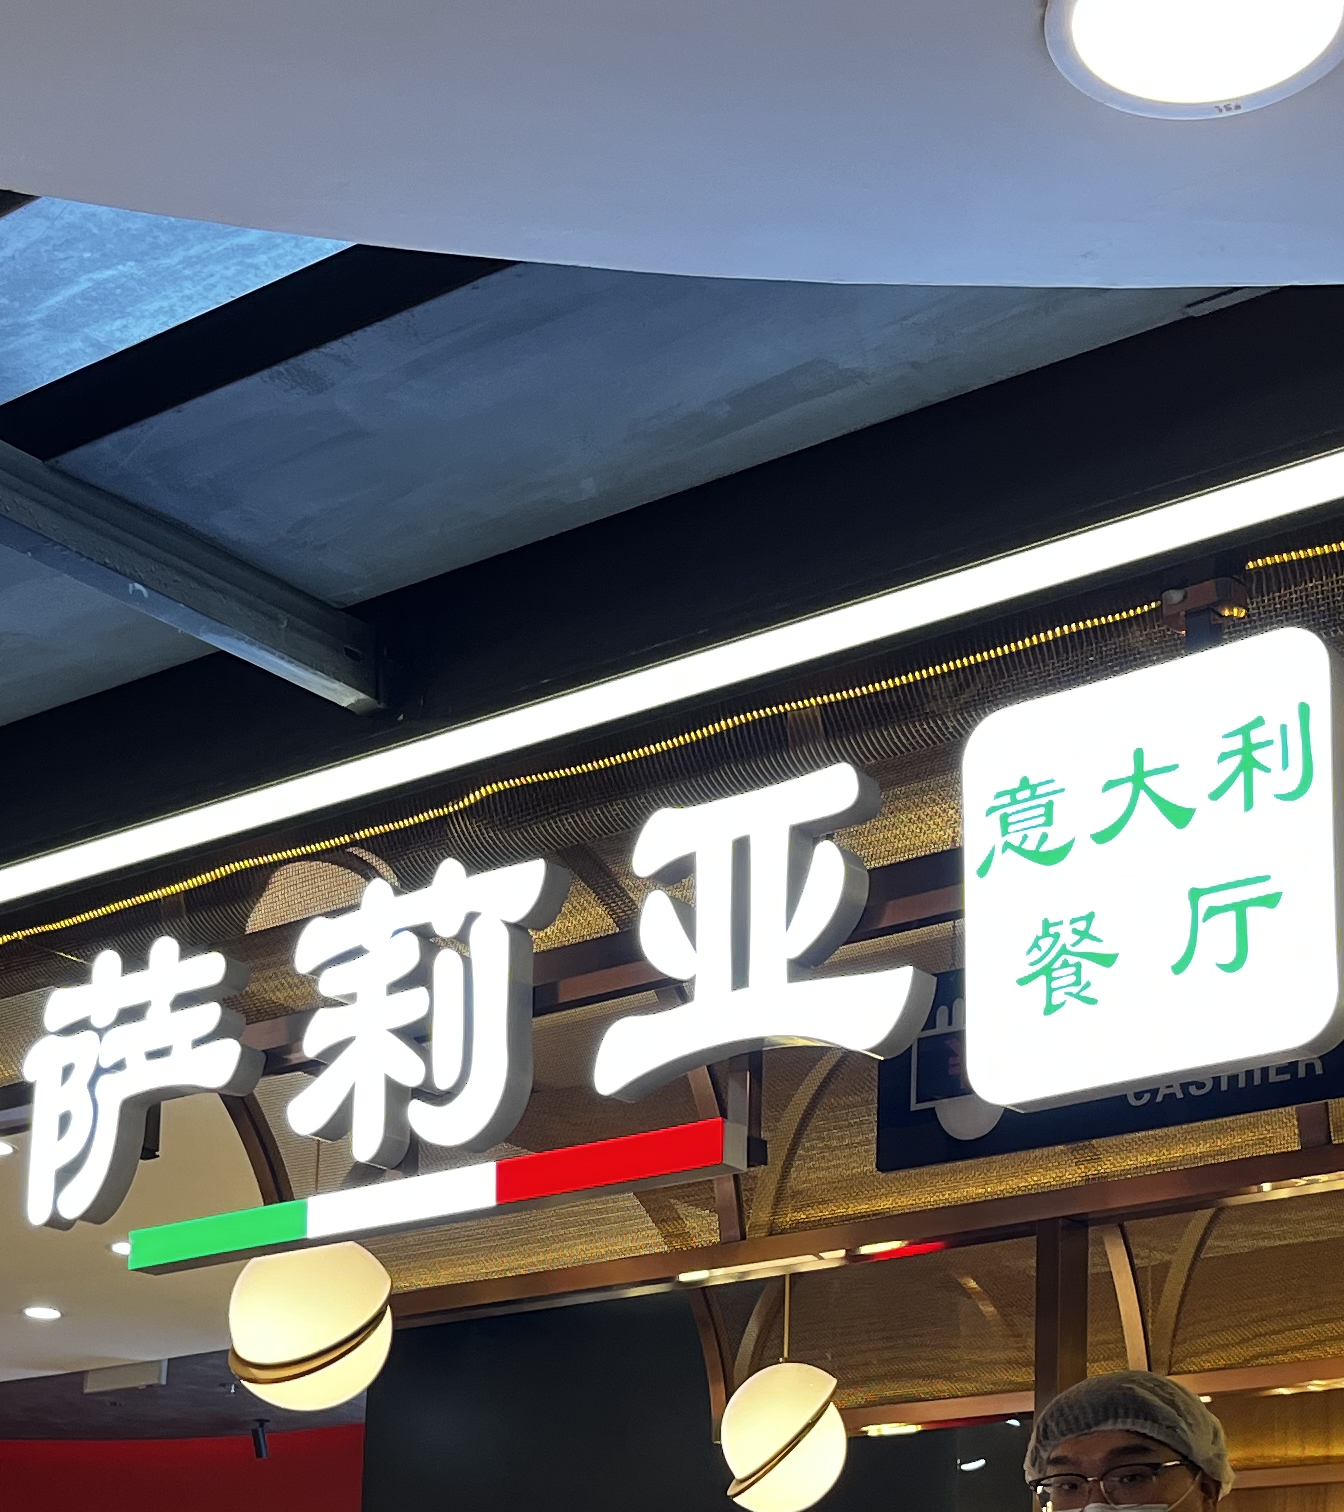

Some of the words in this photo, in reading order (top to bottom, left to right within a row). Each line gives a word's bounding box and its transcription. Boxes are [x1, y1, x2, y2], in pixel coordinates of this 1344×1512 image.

[976, 700, 1315, 879] 意大利
[22, 762, 930, 1228] 萨莉亚
[1015, 874, 1283, 1017] 餐厅
